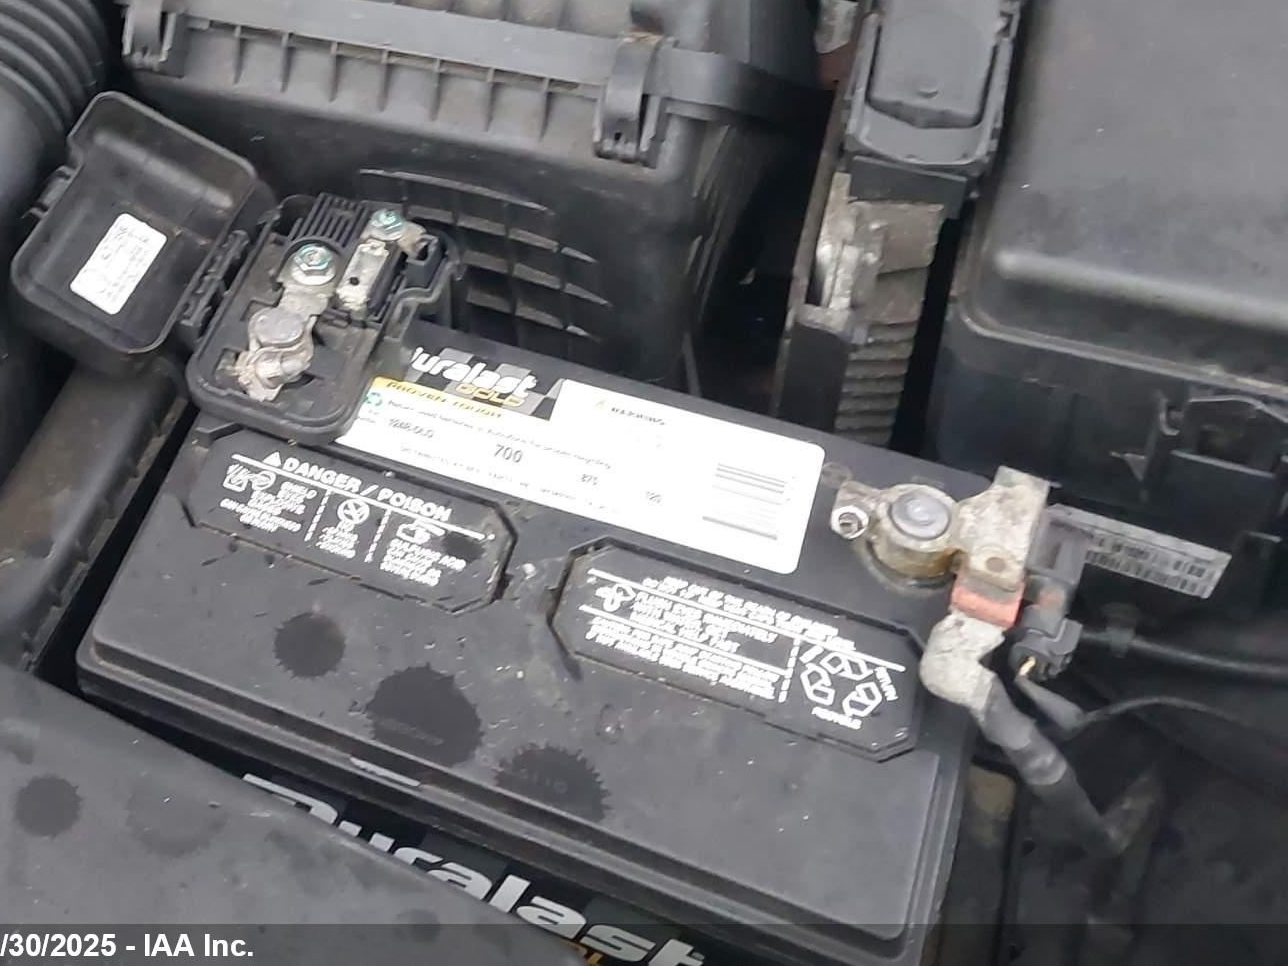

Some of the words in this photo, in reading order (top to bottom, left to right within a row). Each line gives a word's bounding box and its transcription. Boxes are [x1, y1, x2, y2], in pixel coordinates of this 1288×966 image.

[455, 383, 525, 408] GOLD
[494, 443, 524, 464] 700
[282, 457, 362, 493] DANGER
[376, 488, 453, 522] POISON
